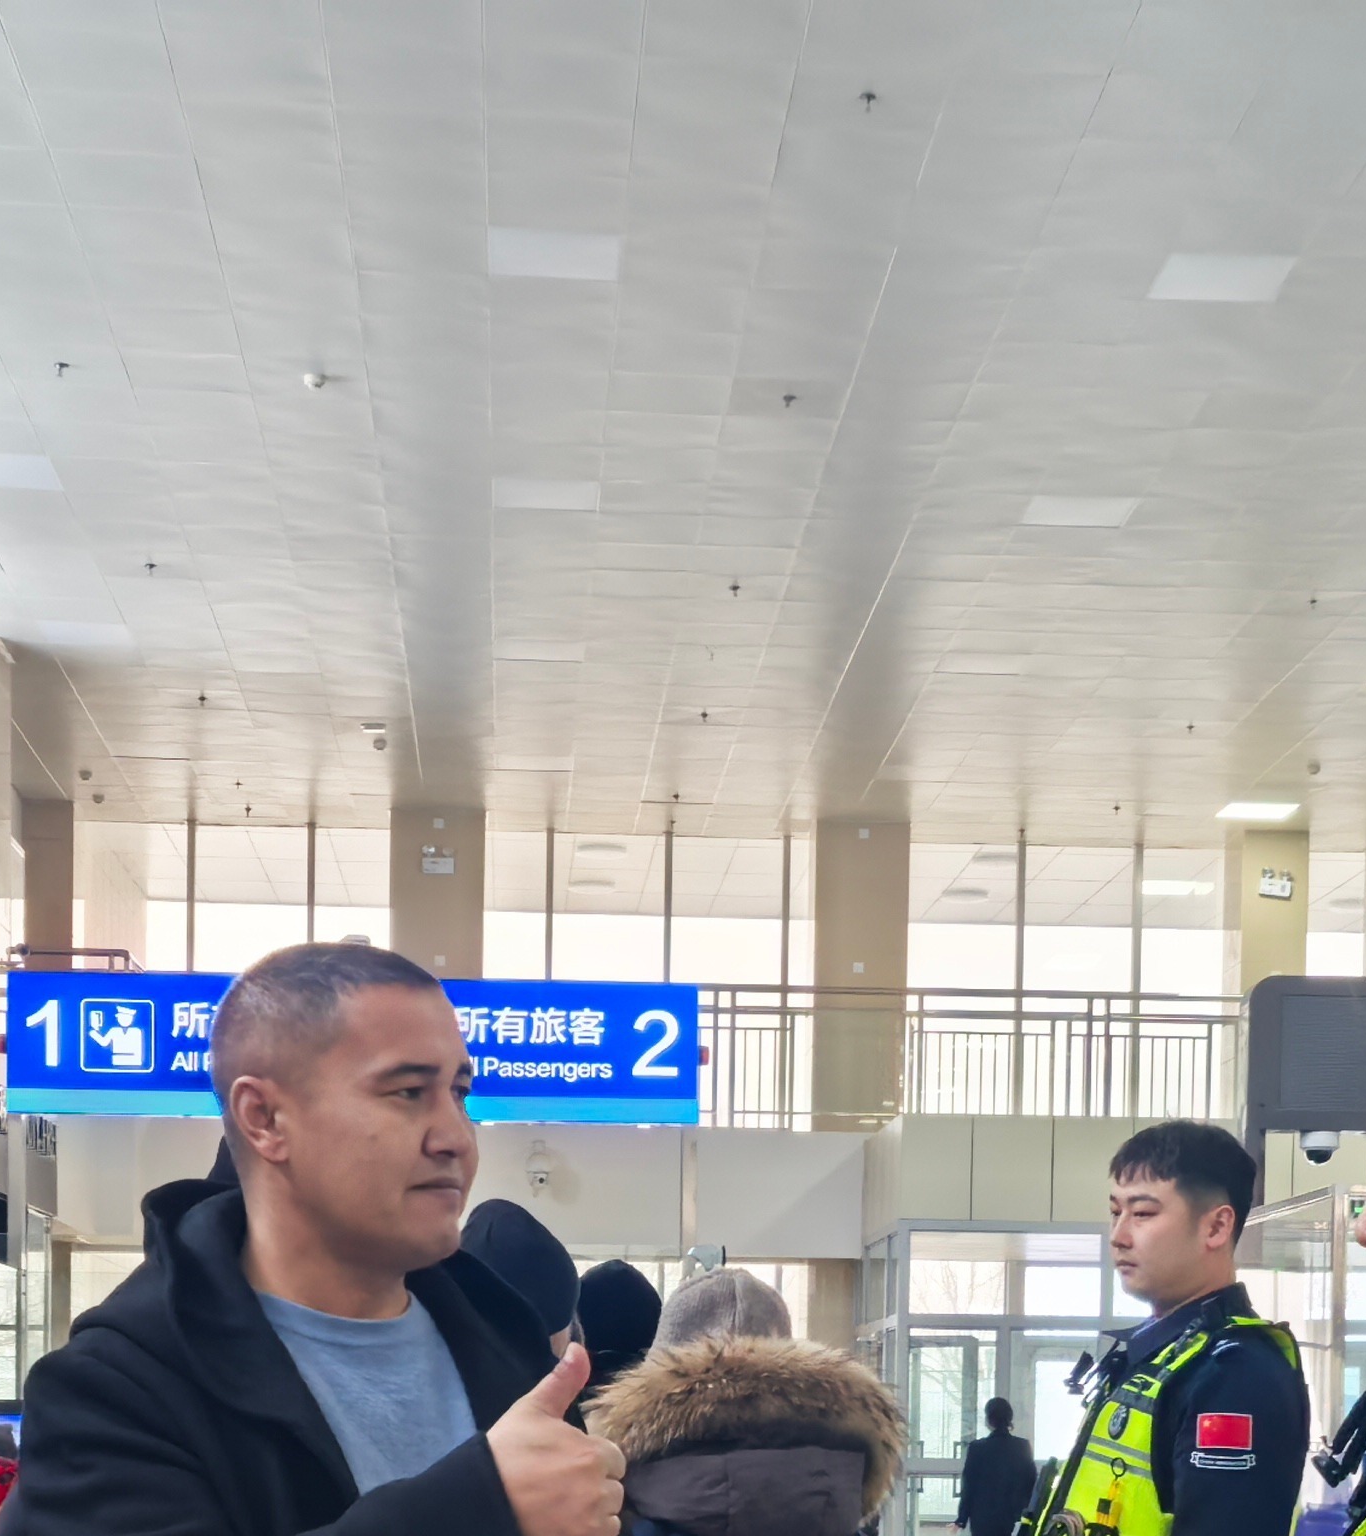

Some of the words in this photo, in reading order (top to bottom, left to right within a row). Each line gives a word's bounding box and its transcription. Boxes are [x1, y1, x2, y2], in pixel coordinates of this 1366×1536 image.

[26, 1000, 59, 1067] 1
[455, 1007, 605, 1045] 所有旅客
[632, 1010, 679, 1077] 2
[170, 1051, 198, 1071] All
[484, 1057, 612, 1082] Passengers
